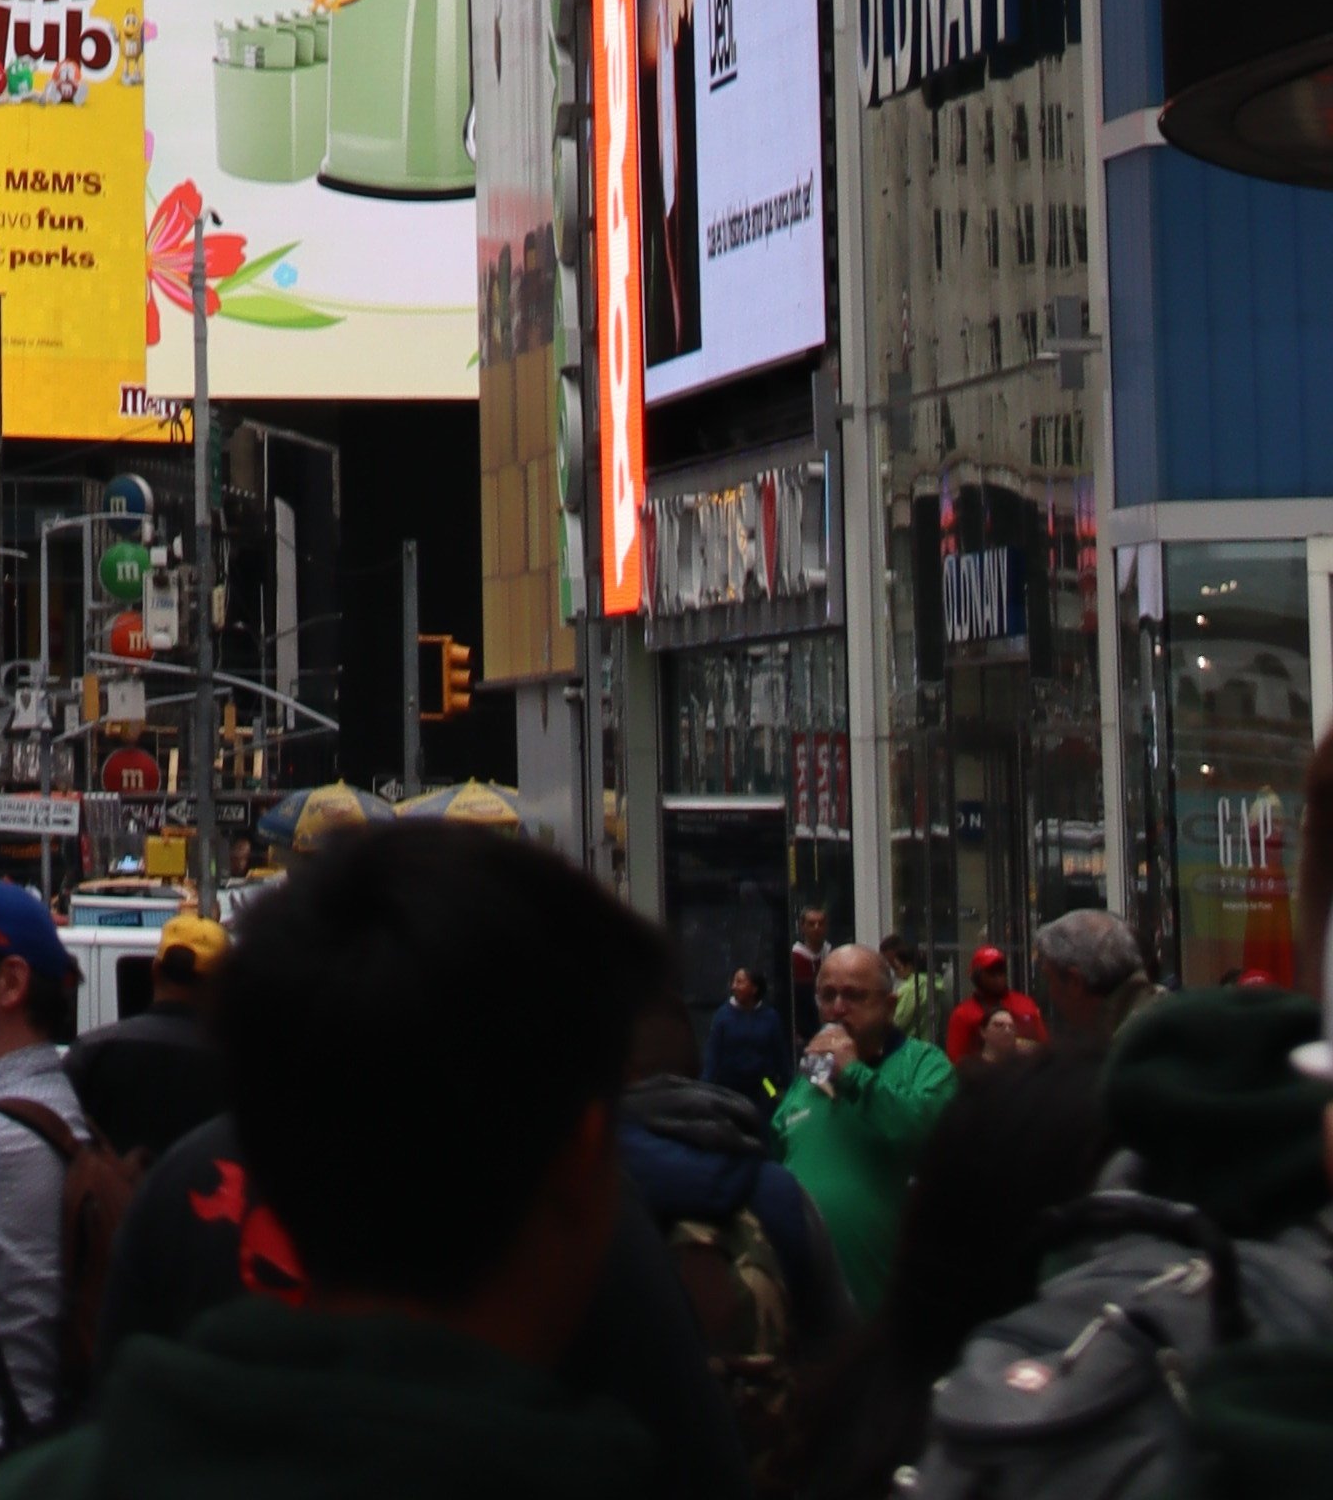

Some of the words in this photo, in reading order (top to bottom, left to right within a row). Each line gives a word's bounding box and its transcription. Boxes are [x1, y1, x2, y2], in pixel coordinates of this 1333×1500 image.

[942, 555, 970, 640] OLD
[971, 546, 1008, 638] NAVY
[122, 768, 143, 788] m
[1218, 797, 1273, 869] GAP
